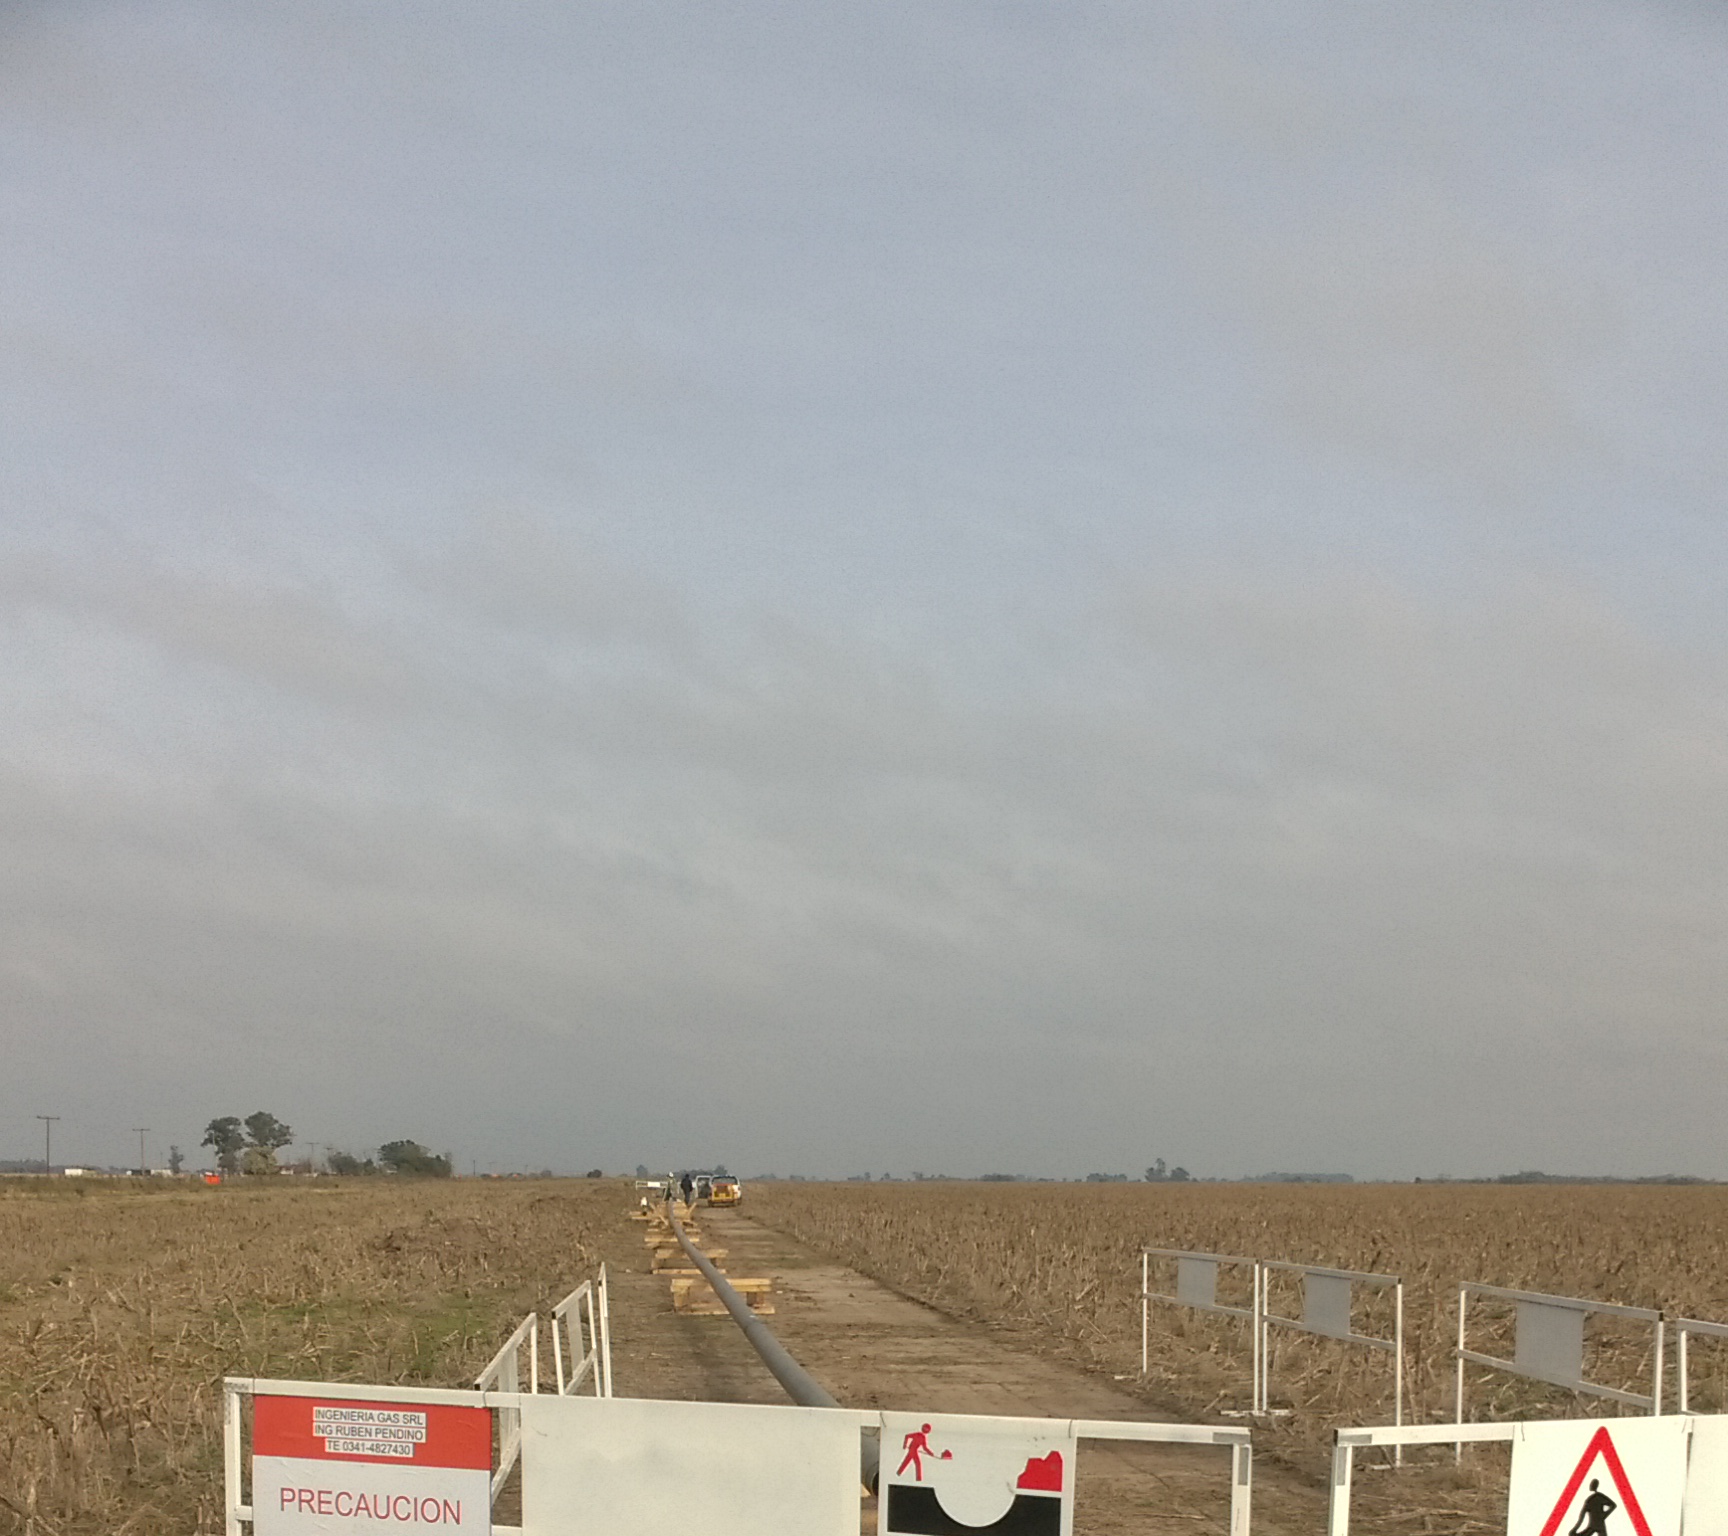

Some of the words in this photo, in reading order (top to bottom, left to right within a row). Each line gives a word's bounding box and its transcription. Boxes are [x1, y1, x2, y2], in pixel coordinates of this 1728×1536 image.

[315, 1409, 375, 1422] INGENIERIA
[377, 1412, 399, 1424] GAS
[402, 1414, 423, 1425] SRL
[315, 1424, 333, 1435] ING
[335, 1426, 372, 1438] RUBEN
[374, 1427, 423, 1440] PENDINO
[327, 1440, 340, 1451] TE
[342, 1441, 411, 1455] 0341-4827430
[280, 1487, 461, 1525] PRECAUCION
